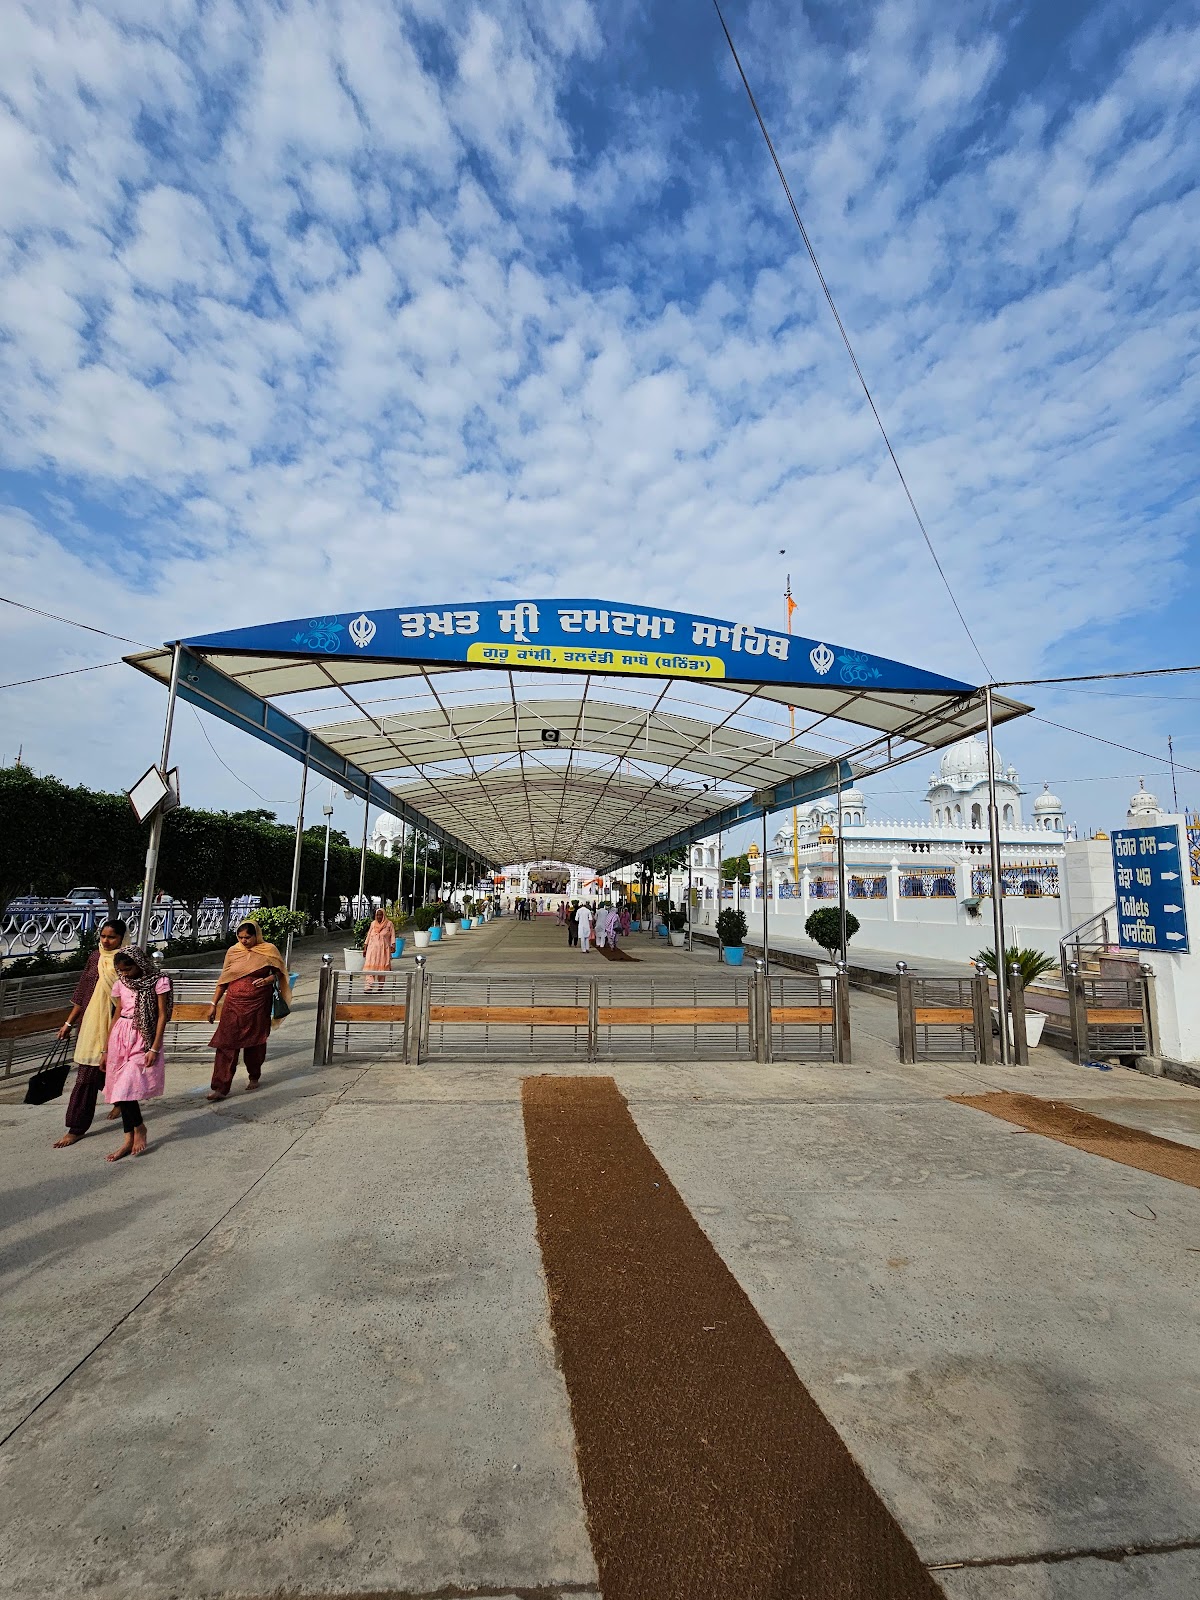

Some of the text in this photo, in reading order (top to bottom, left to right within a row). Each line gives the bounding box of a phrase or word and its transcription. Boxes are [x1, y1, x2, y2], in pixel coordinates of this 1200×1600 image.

[399, 602, 791, 661] ਤਖ਼ਤ ਸ੍ਰੀ ਦਮਦਮਾ ਸਾਹਿਬ
[483, 648, 509, 664] ਗੁਰੂ
[563, 651, 614, 664] ਤਲਵੰਡੀ
[1115, 833, 1157, 856] ਲੰਗਰ ਹਾਲ
[1135, 867, 1152, 886] ਘਰ
[1120, 896, 1149, 917] Toilets
[1122, 918, 1157, 944] ਪਾਰਕਿੰਗ
